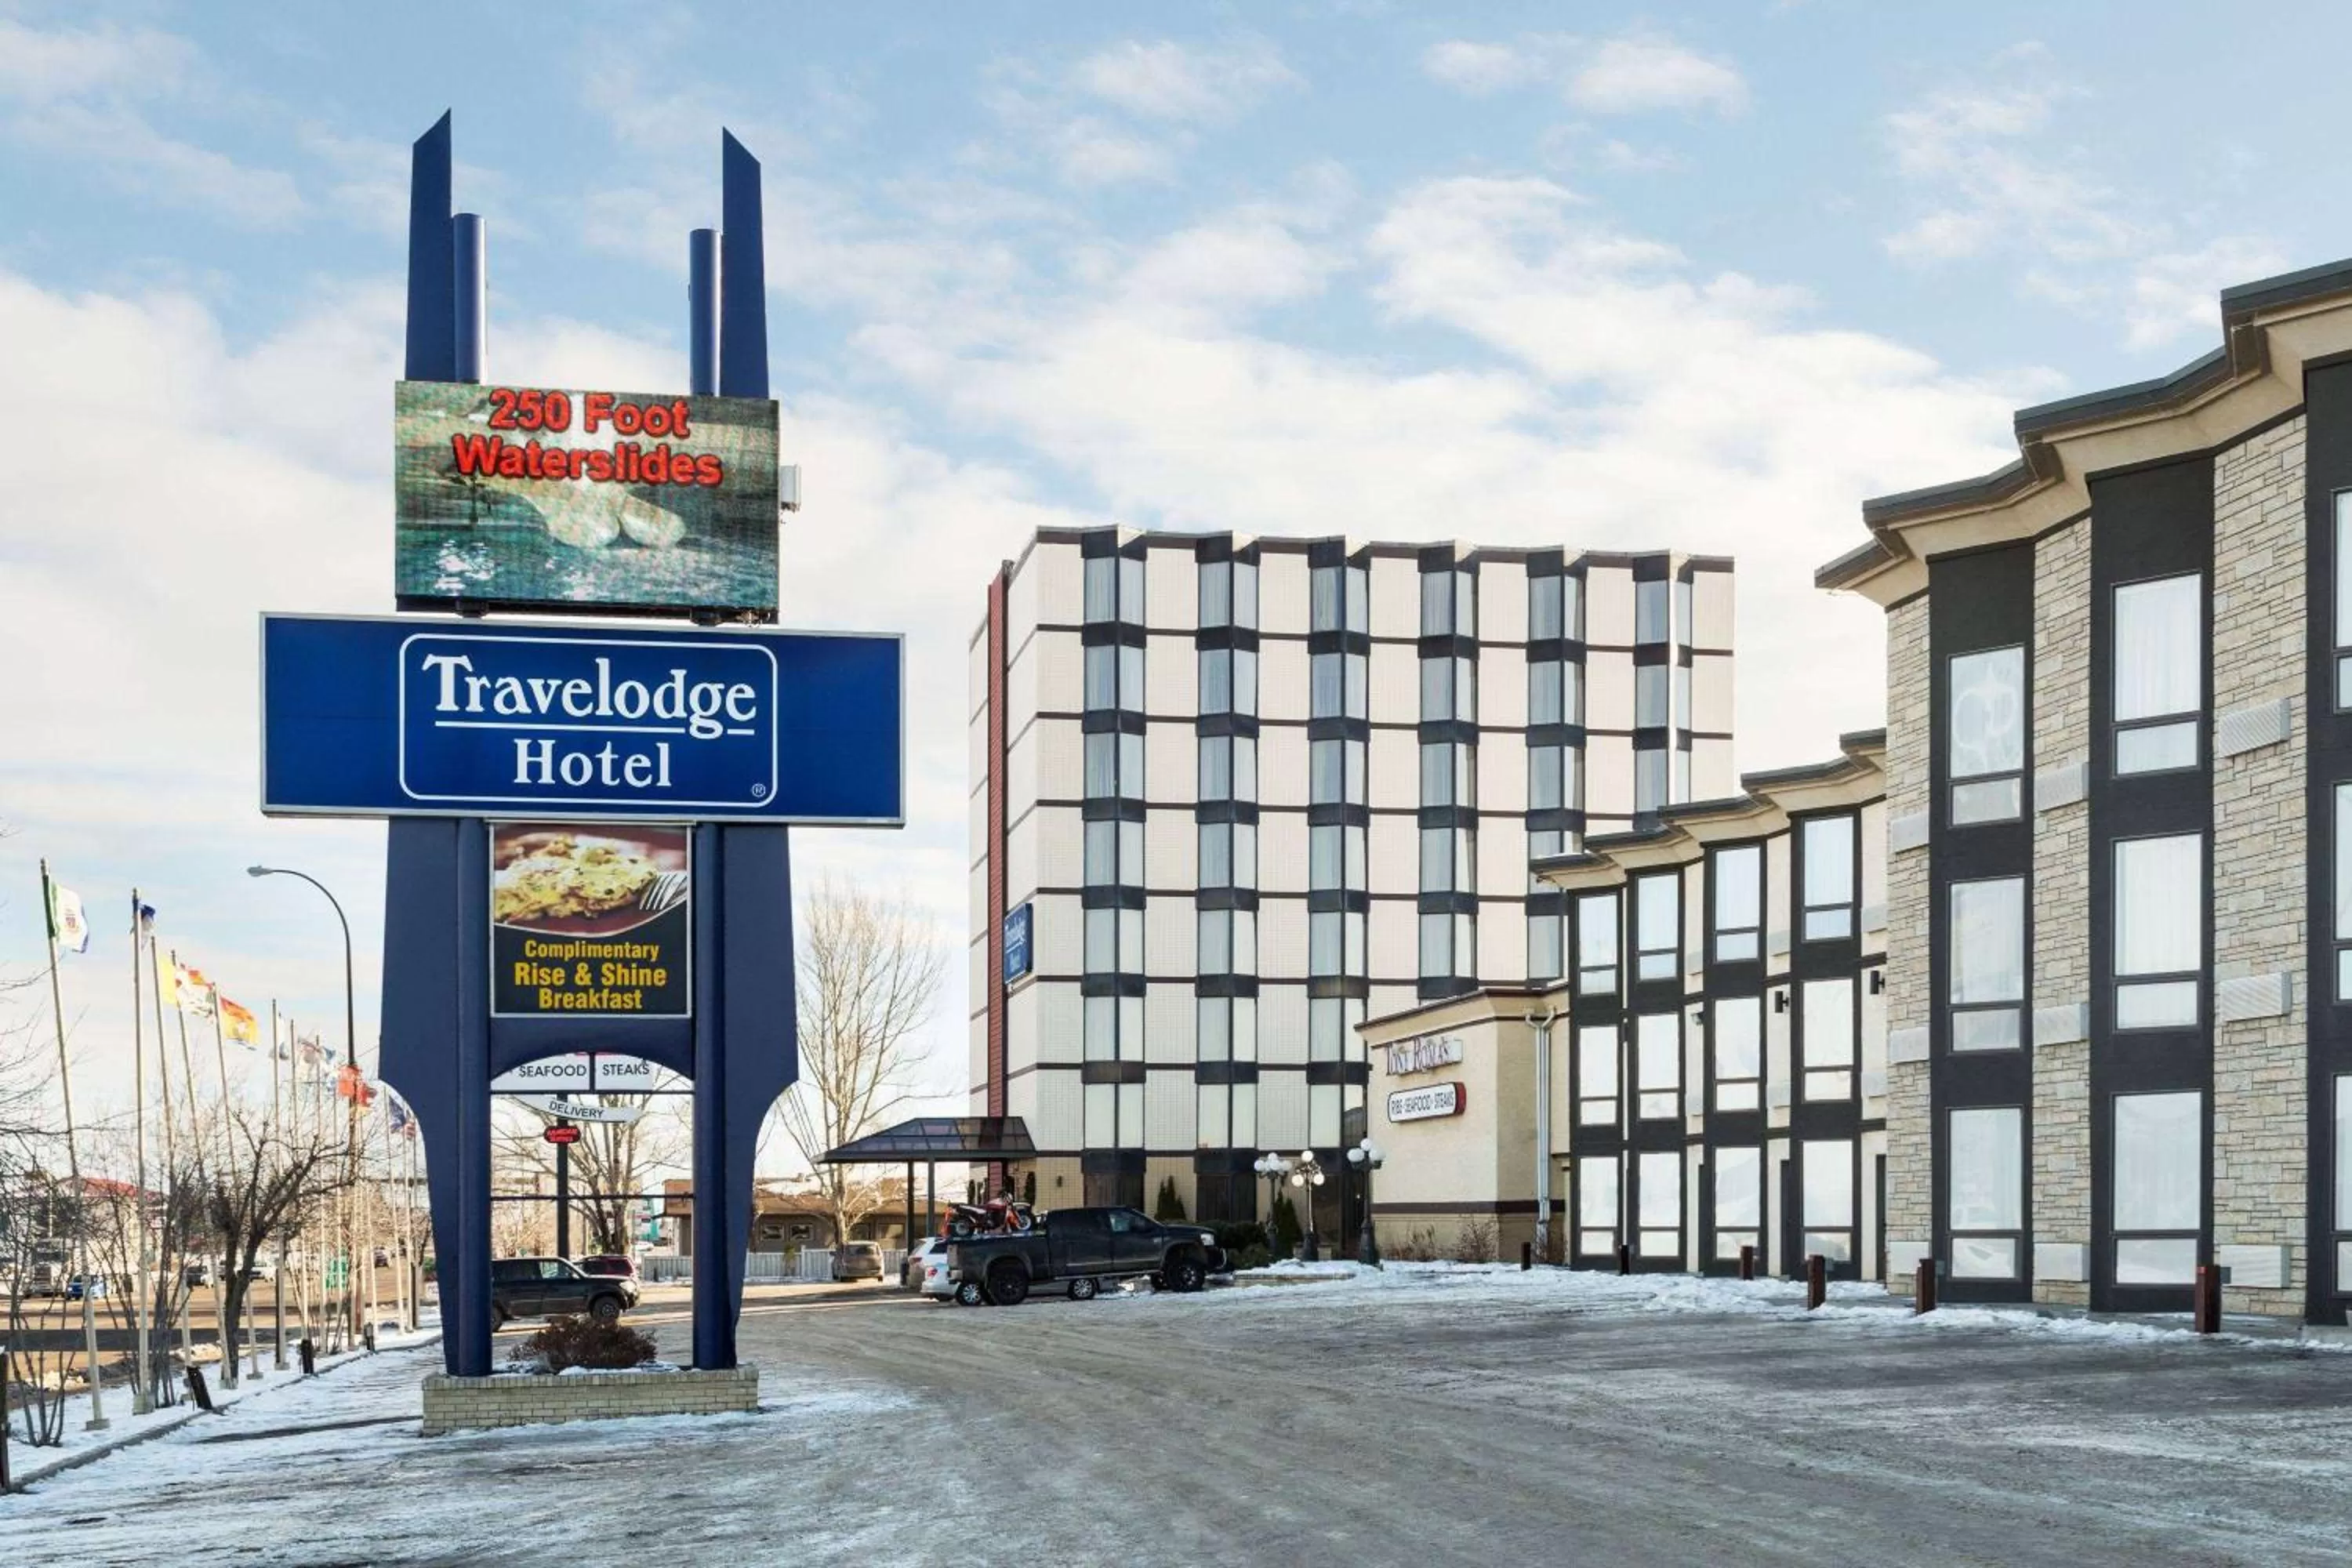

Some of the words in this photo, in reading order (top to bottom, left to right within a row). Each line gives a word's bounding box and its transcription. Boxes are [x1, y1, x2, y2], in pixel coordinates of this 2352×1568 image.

[488, 388, 571, 432] 250
[583, 392, 691, 437] Foot
[452, 433, 724, 488] Waterslides
[422, 655, 757, 739] Travelodge
[514, 739, 671, 787] Hotel
[524, 940, 659, 962] Complimentary
[514, 962, 565, 985] Rise
[574, 963, 592, 985] &
[601, 963, 667, 987] Shine
[539, 989, 643, 1010] Breakfast
[518, 1064, 587, 1077] SEAFOOD
[602, 1063, 650, 1076] STEAKS
[549, 1101, 604, 1119] DELIVERY
